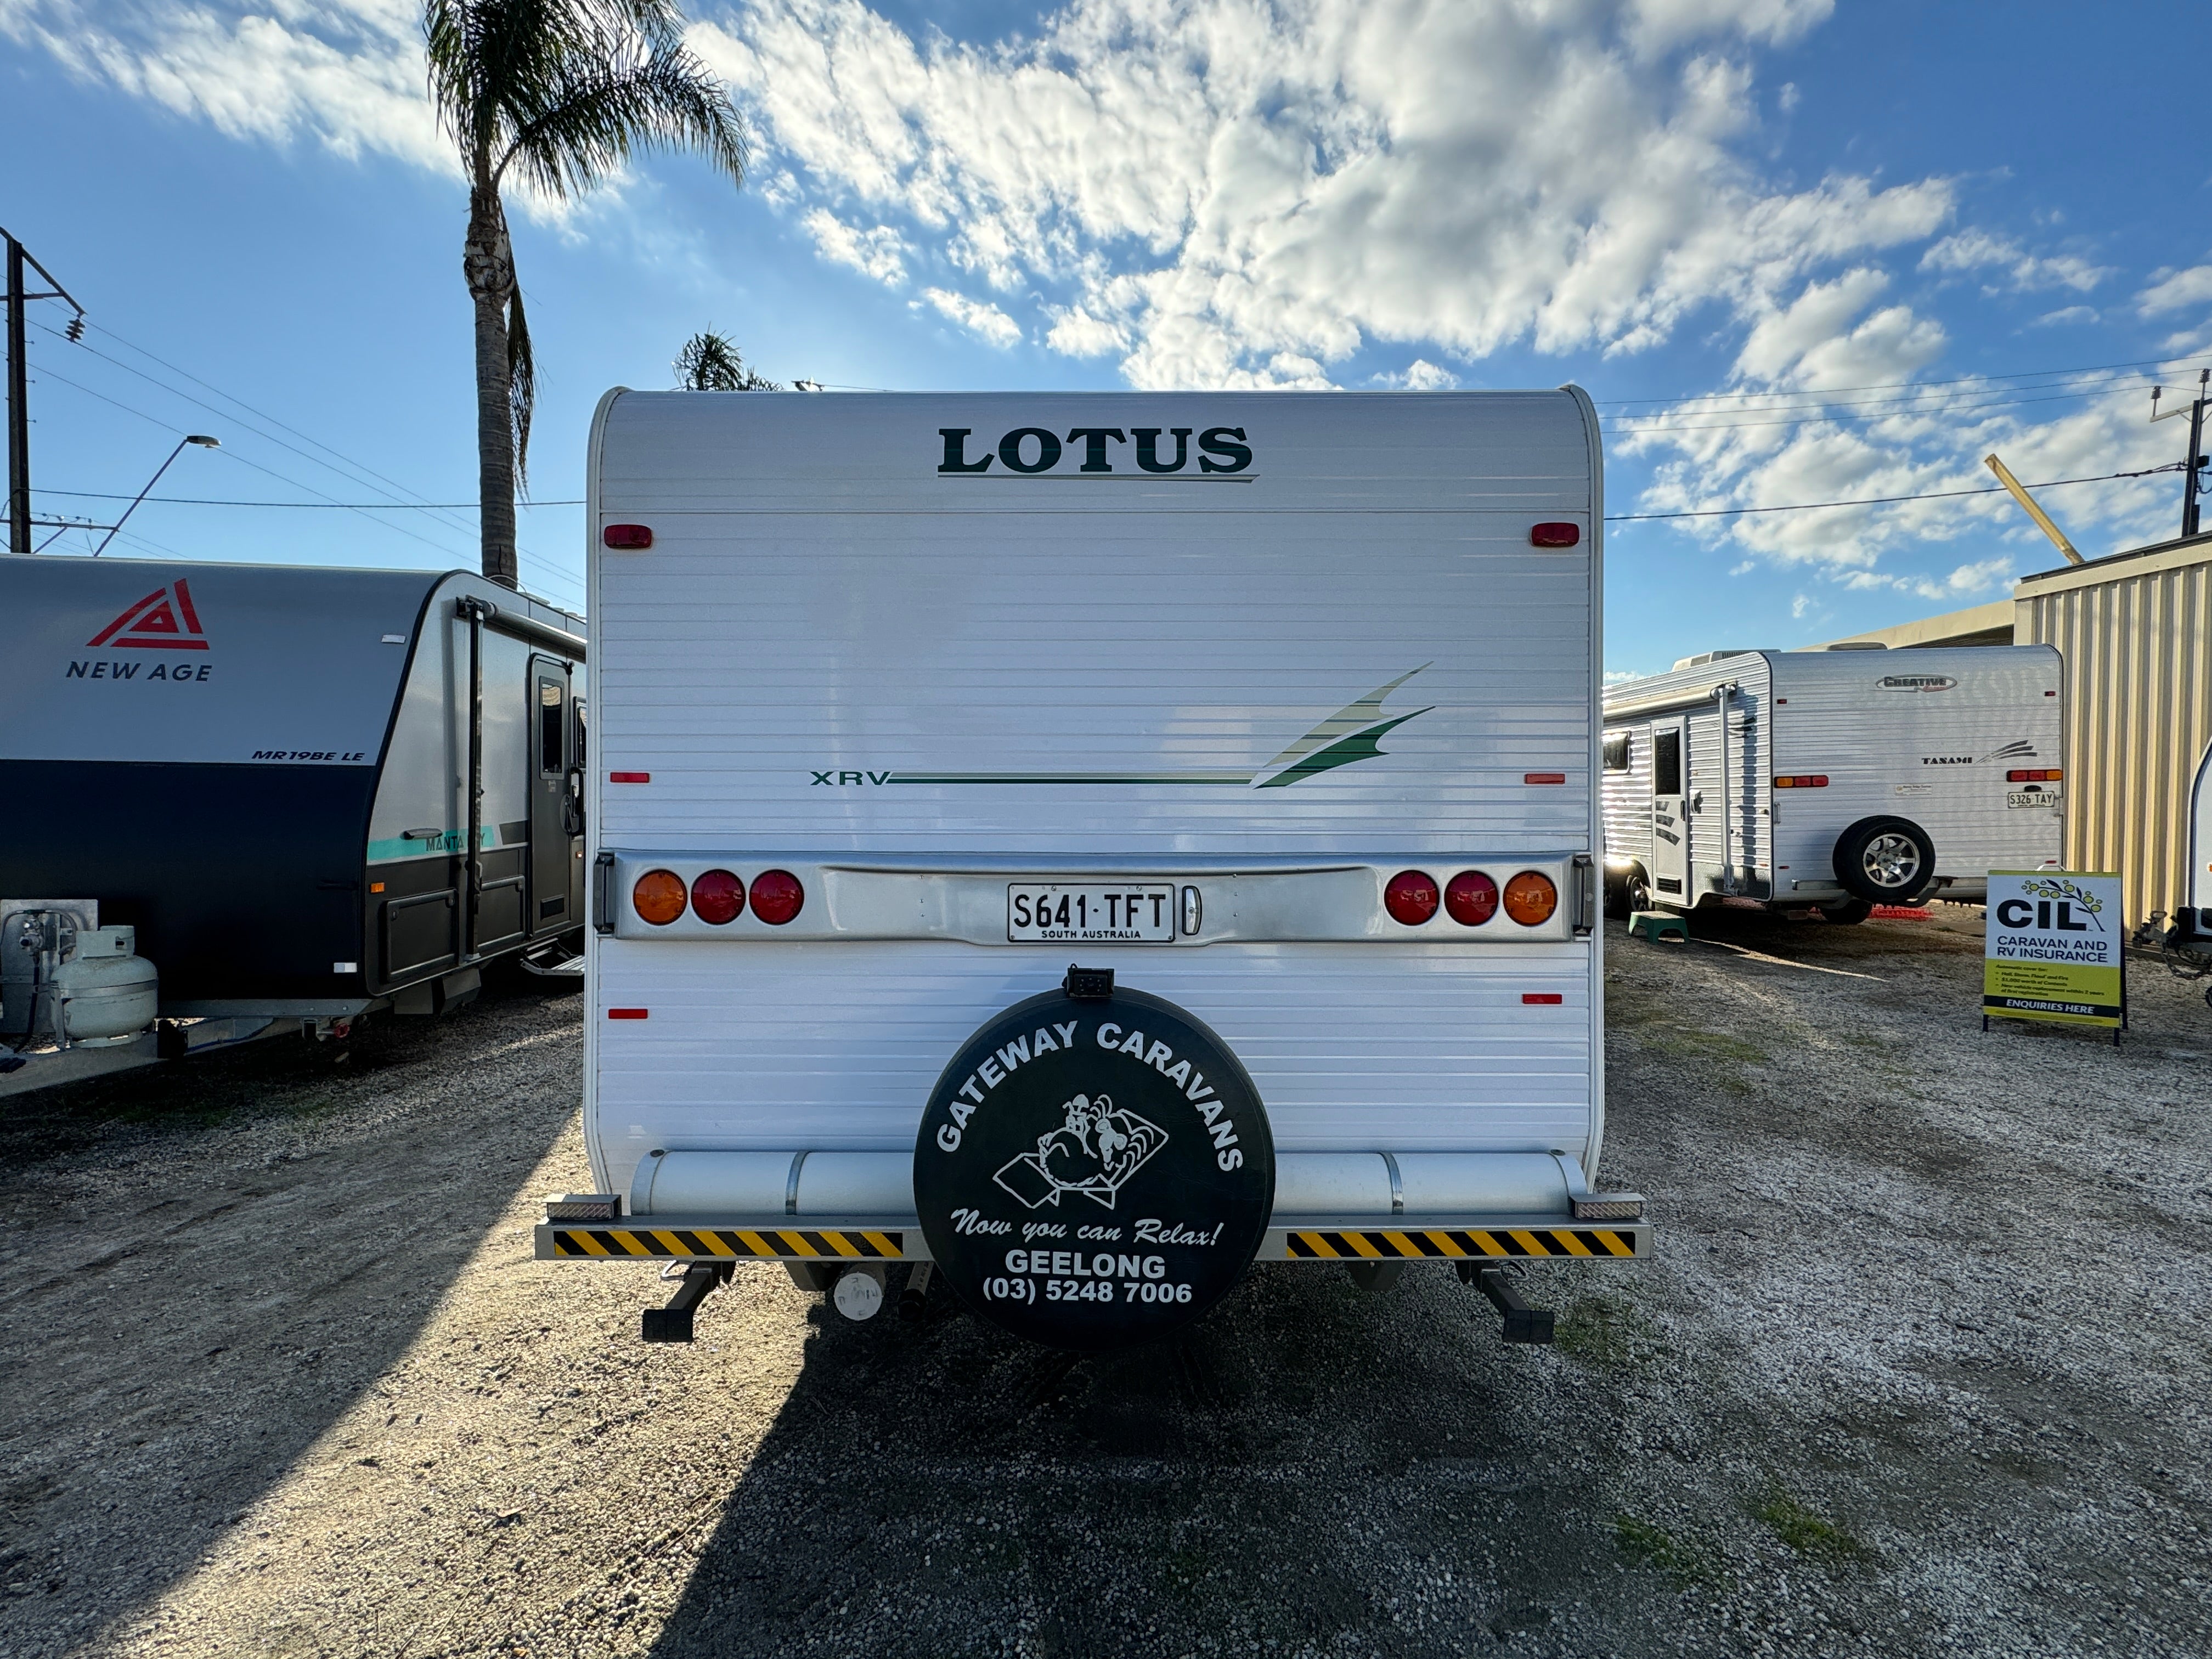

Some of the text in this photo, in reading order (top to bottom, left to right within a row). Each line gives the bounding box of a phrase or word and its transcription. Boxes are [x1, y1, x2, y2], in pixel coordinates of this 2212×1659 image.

[938, 427, 1252, 473] LOTUS
[66, 661, 212, 682] NEW AGE
[251, 751, 365, 761] MR19BE LE
[810, 771, 890, 786] XRV
[426, 835, 464, 851] MANTA
[1997, 899, 2087, 932] CIL
[1082, 930, 1141, 939] AUSTRALIA
[1997, 936, 2107, 951] CARAVAN AND
[1997, 947, 2108, 963] RV INSURANCE
[2006, 998, 2095, 1014] ENQUIRIES HERE
[936, 1020, 1243, 1172] GATEWAY CARAVANS
[950, 1208, 1224, 1246] Now you can Relax!
[1005, 1249, 1165, 1278] GEELONG
[983, 1277, 1192, 1305] (03) 5248 7006
